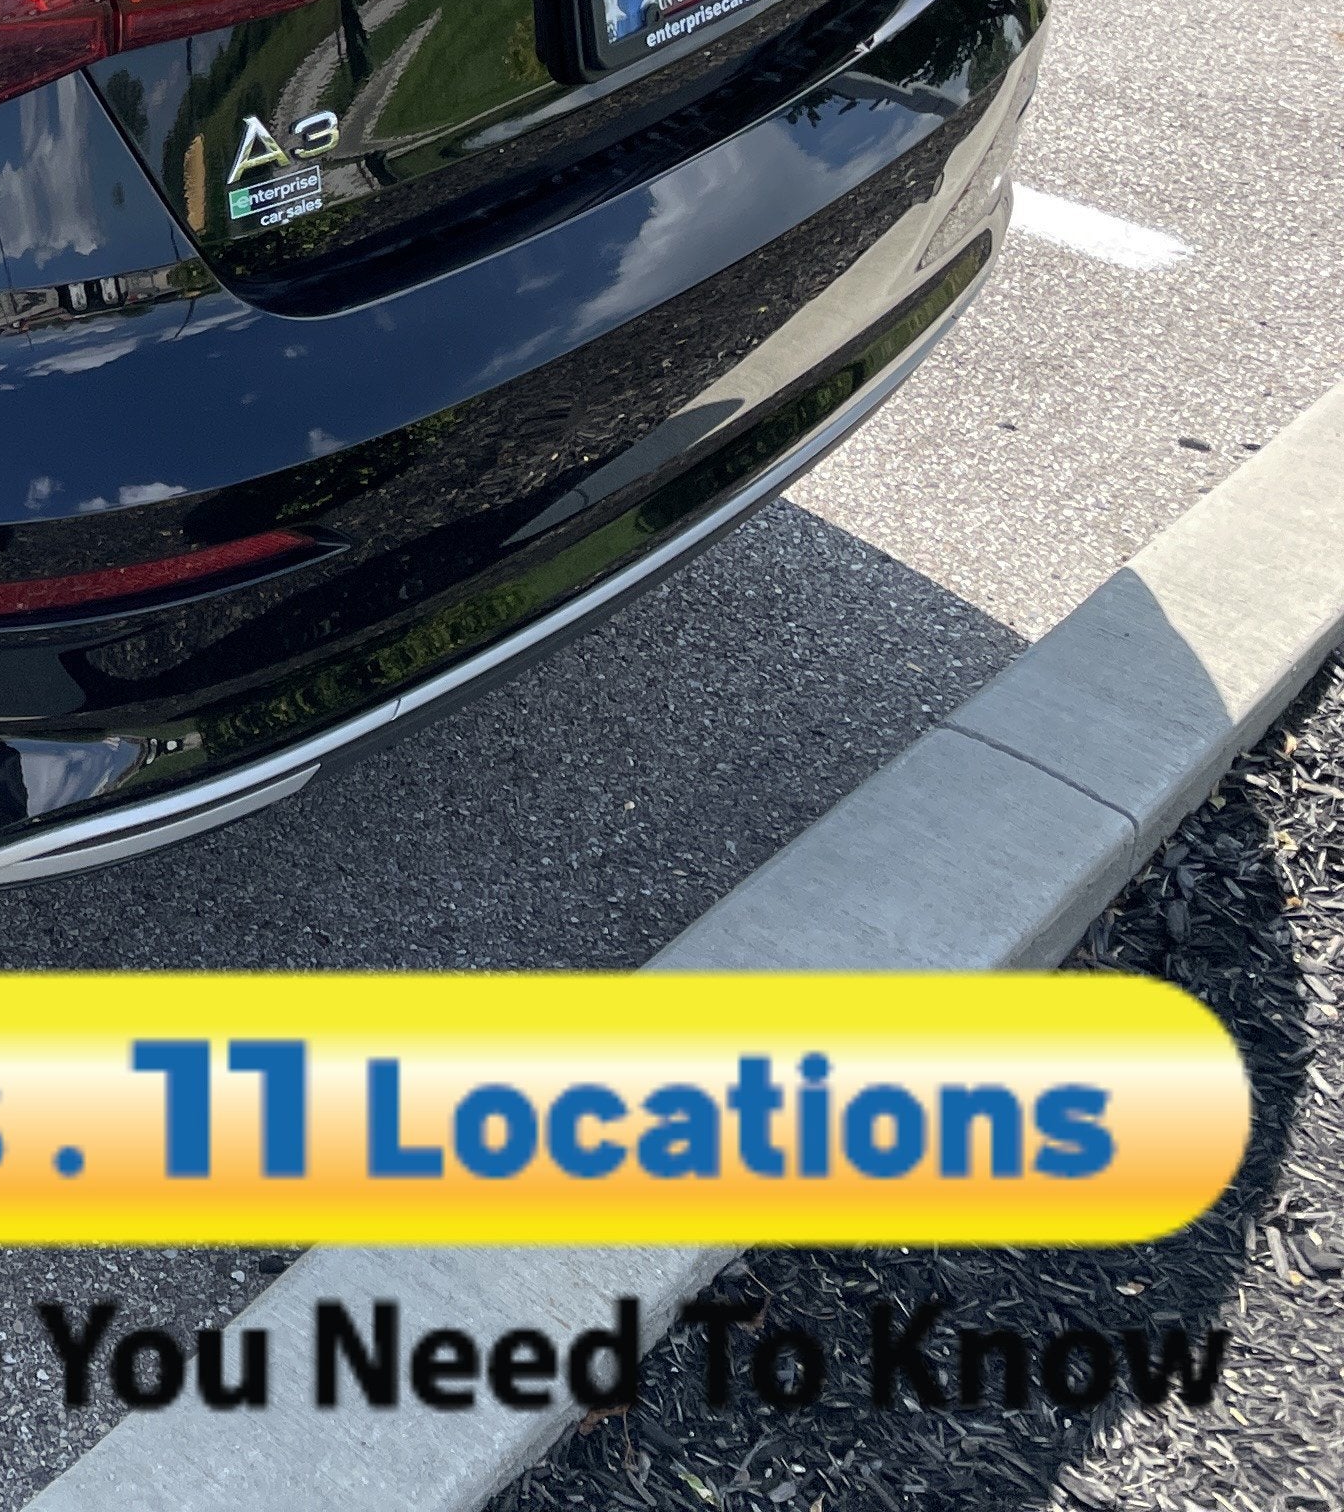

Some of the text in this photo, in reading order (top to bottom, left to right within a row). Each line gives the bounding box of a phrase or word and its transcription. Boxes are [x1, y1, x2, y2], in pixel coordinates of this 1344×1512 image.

[226, 110, 340, 185] A3
[232, 173, 319, 209] enterprise
[259, 197, 324, 227] car sales
